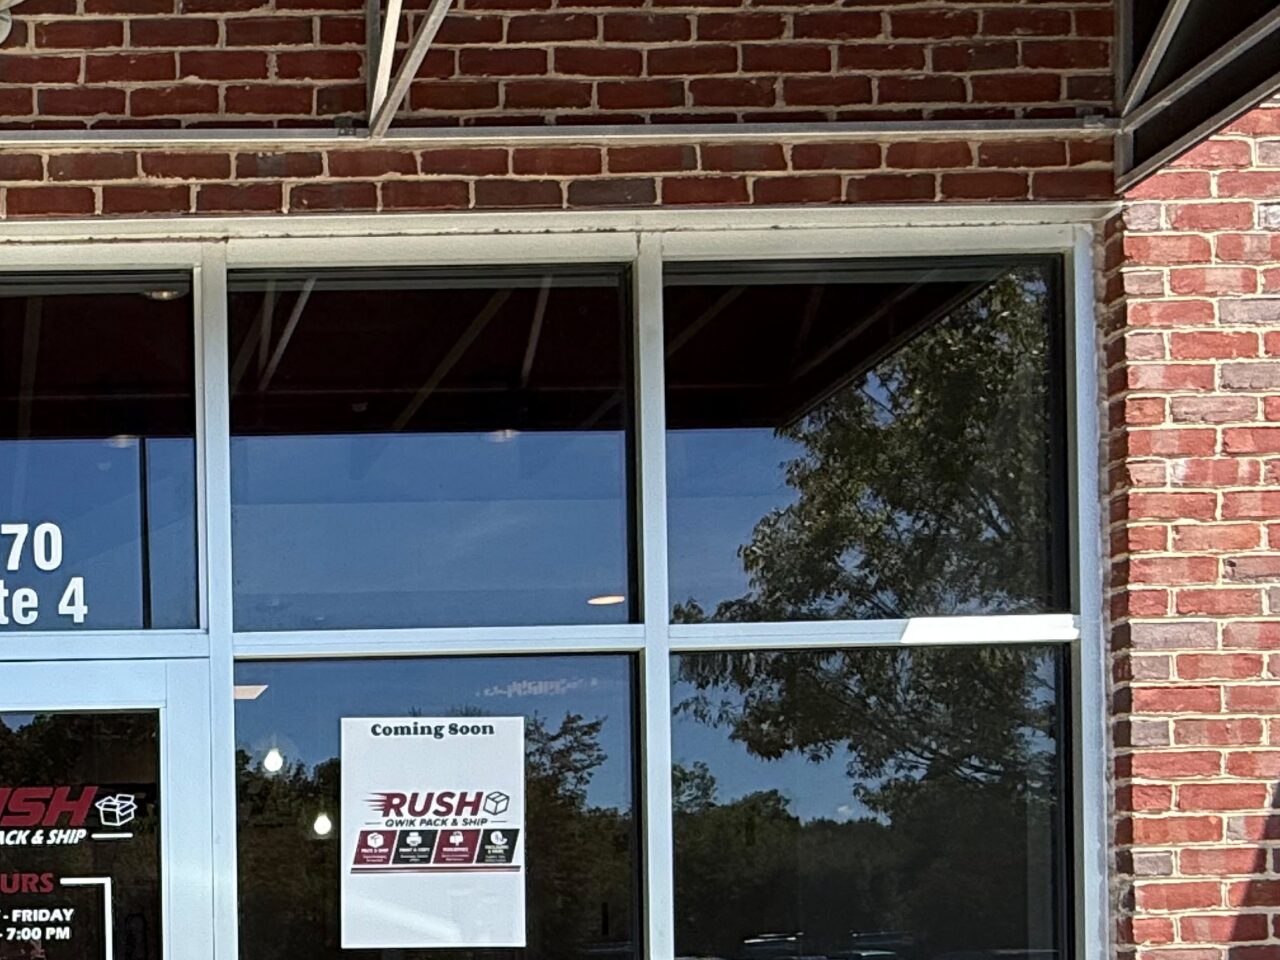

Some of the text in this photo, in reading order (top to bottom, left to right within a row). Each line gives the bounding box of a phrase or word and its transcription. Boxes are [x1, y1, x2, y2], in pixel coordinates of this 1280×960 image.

[58, 577, 88, 624] 4
[371, 721, 495, 739] Coming Soon
[375, 791, 484, 817] RUSH
[385, 817, 488, 828] QWIK PACK & SHIP
[30, 830, 45, 845] &
[46, 828, 87, 845] SHIP
[11, 908, 74, 922] FRIDAY
[6, 927, 42, 940] 7:00
[45, 926, 70, 940] PM
